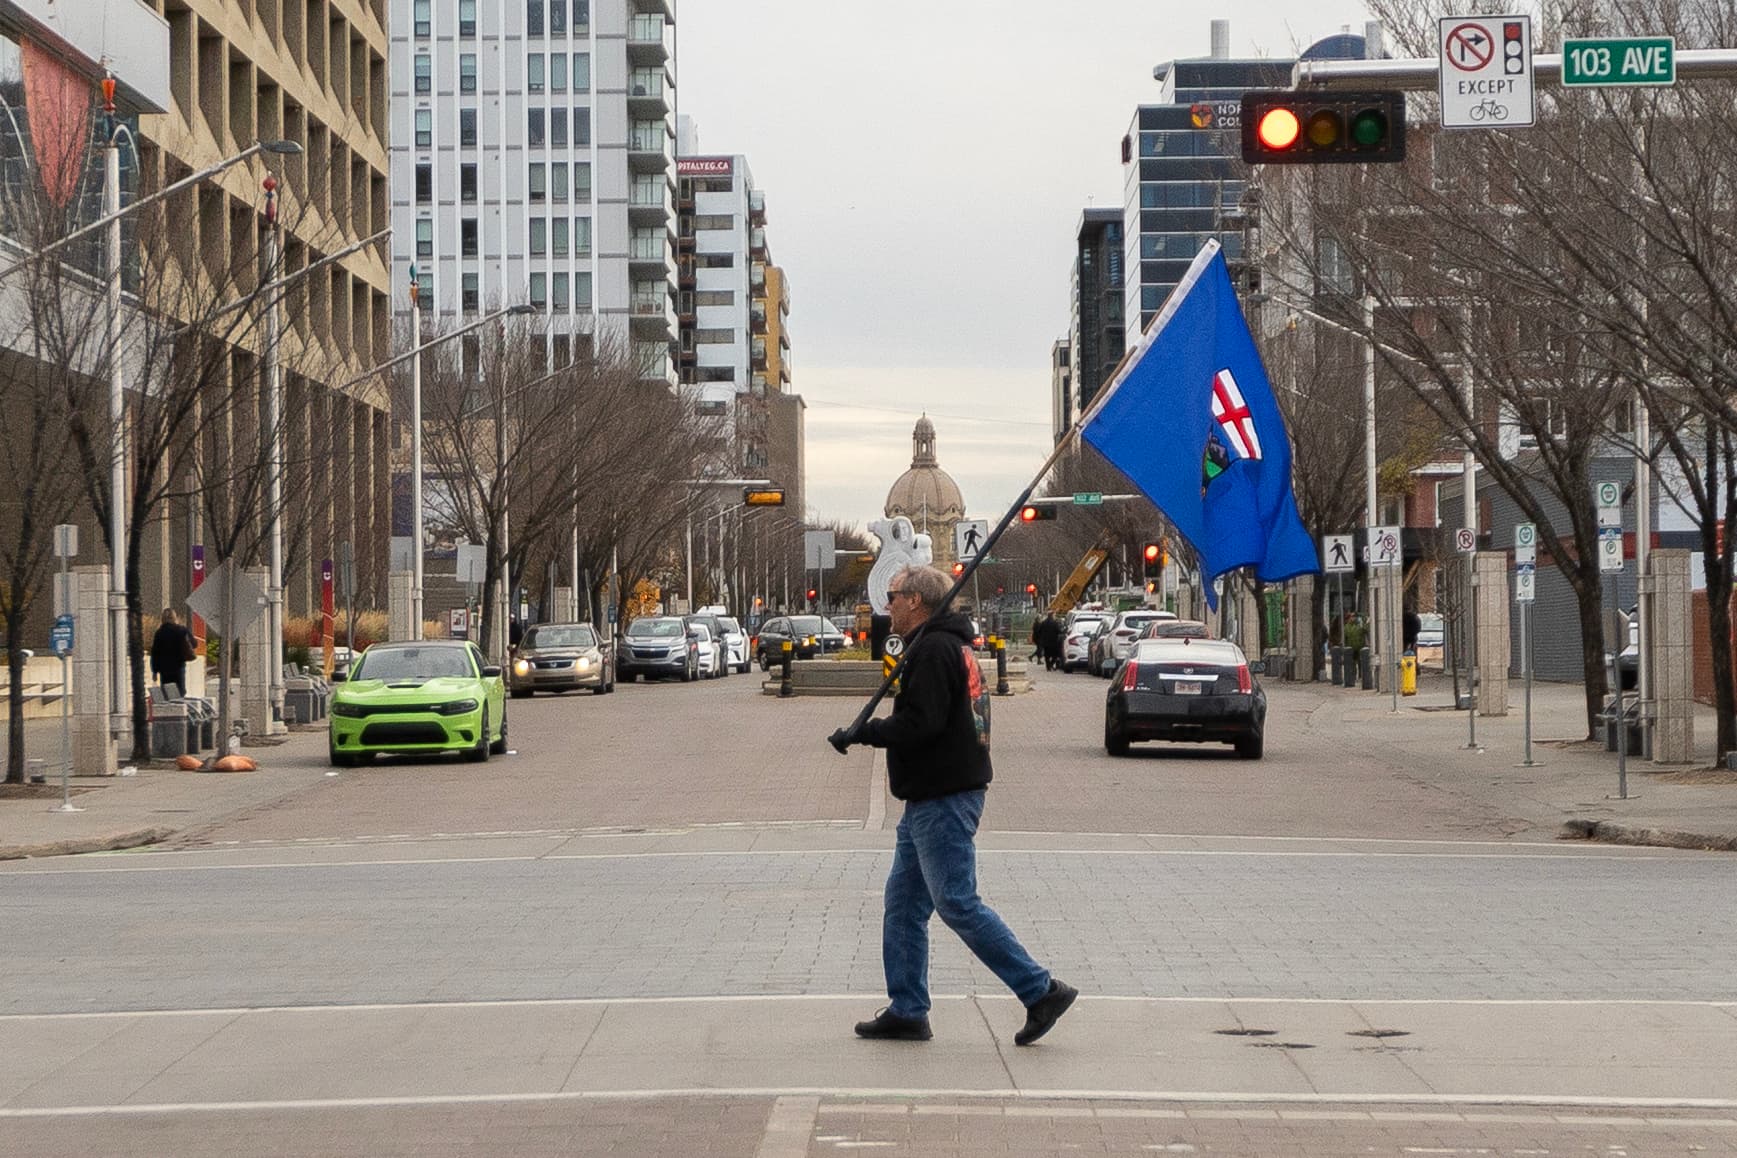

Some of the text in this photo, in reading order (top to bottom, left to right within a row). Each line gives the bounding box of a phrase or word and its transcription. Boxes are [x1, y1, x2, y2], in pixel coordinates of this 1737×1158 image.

[1570, 47, 1668, 76] 103 AVE
[1458, 80, 1515, 95] EXCEPT
